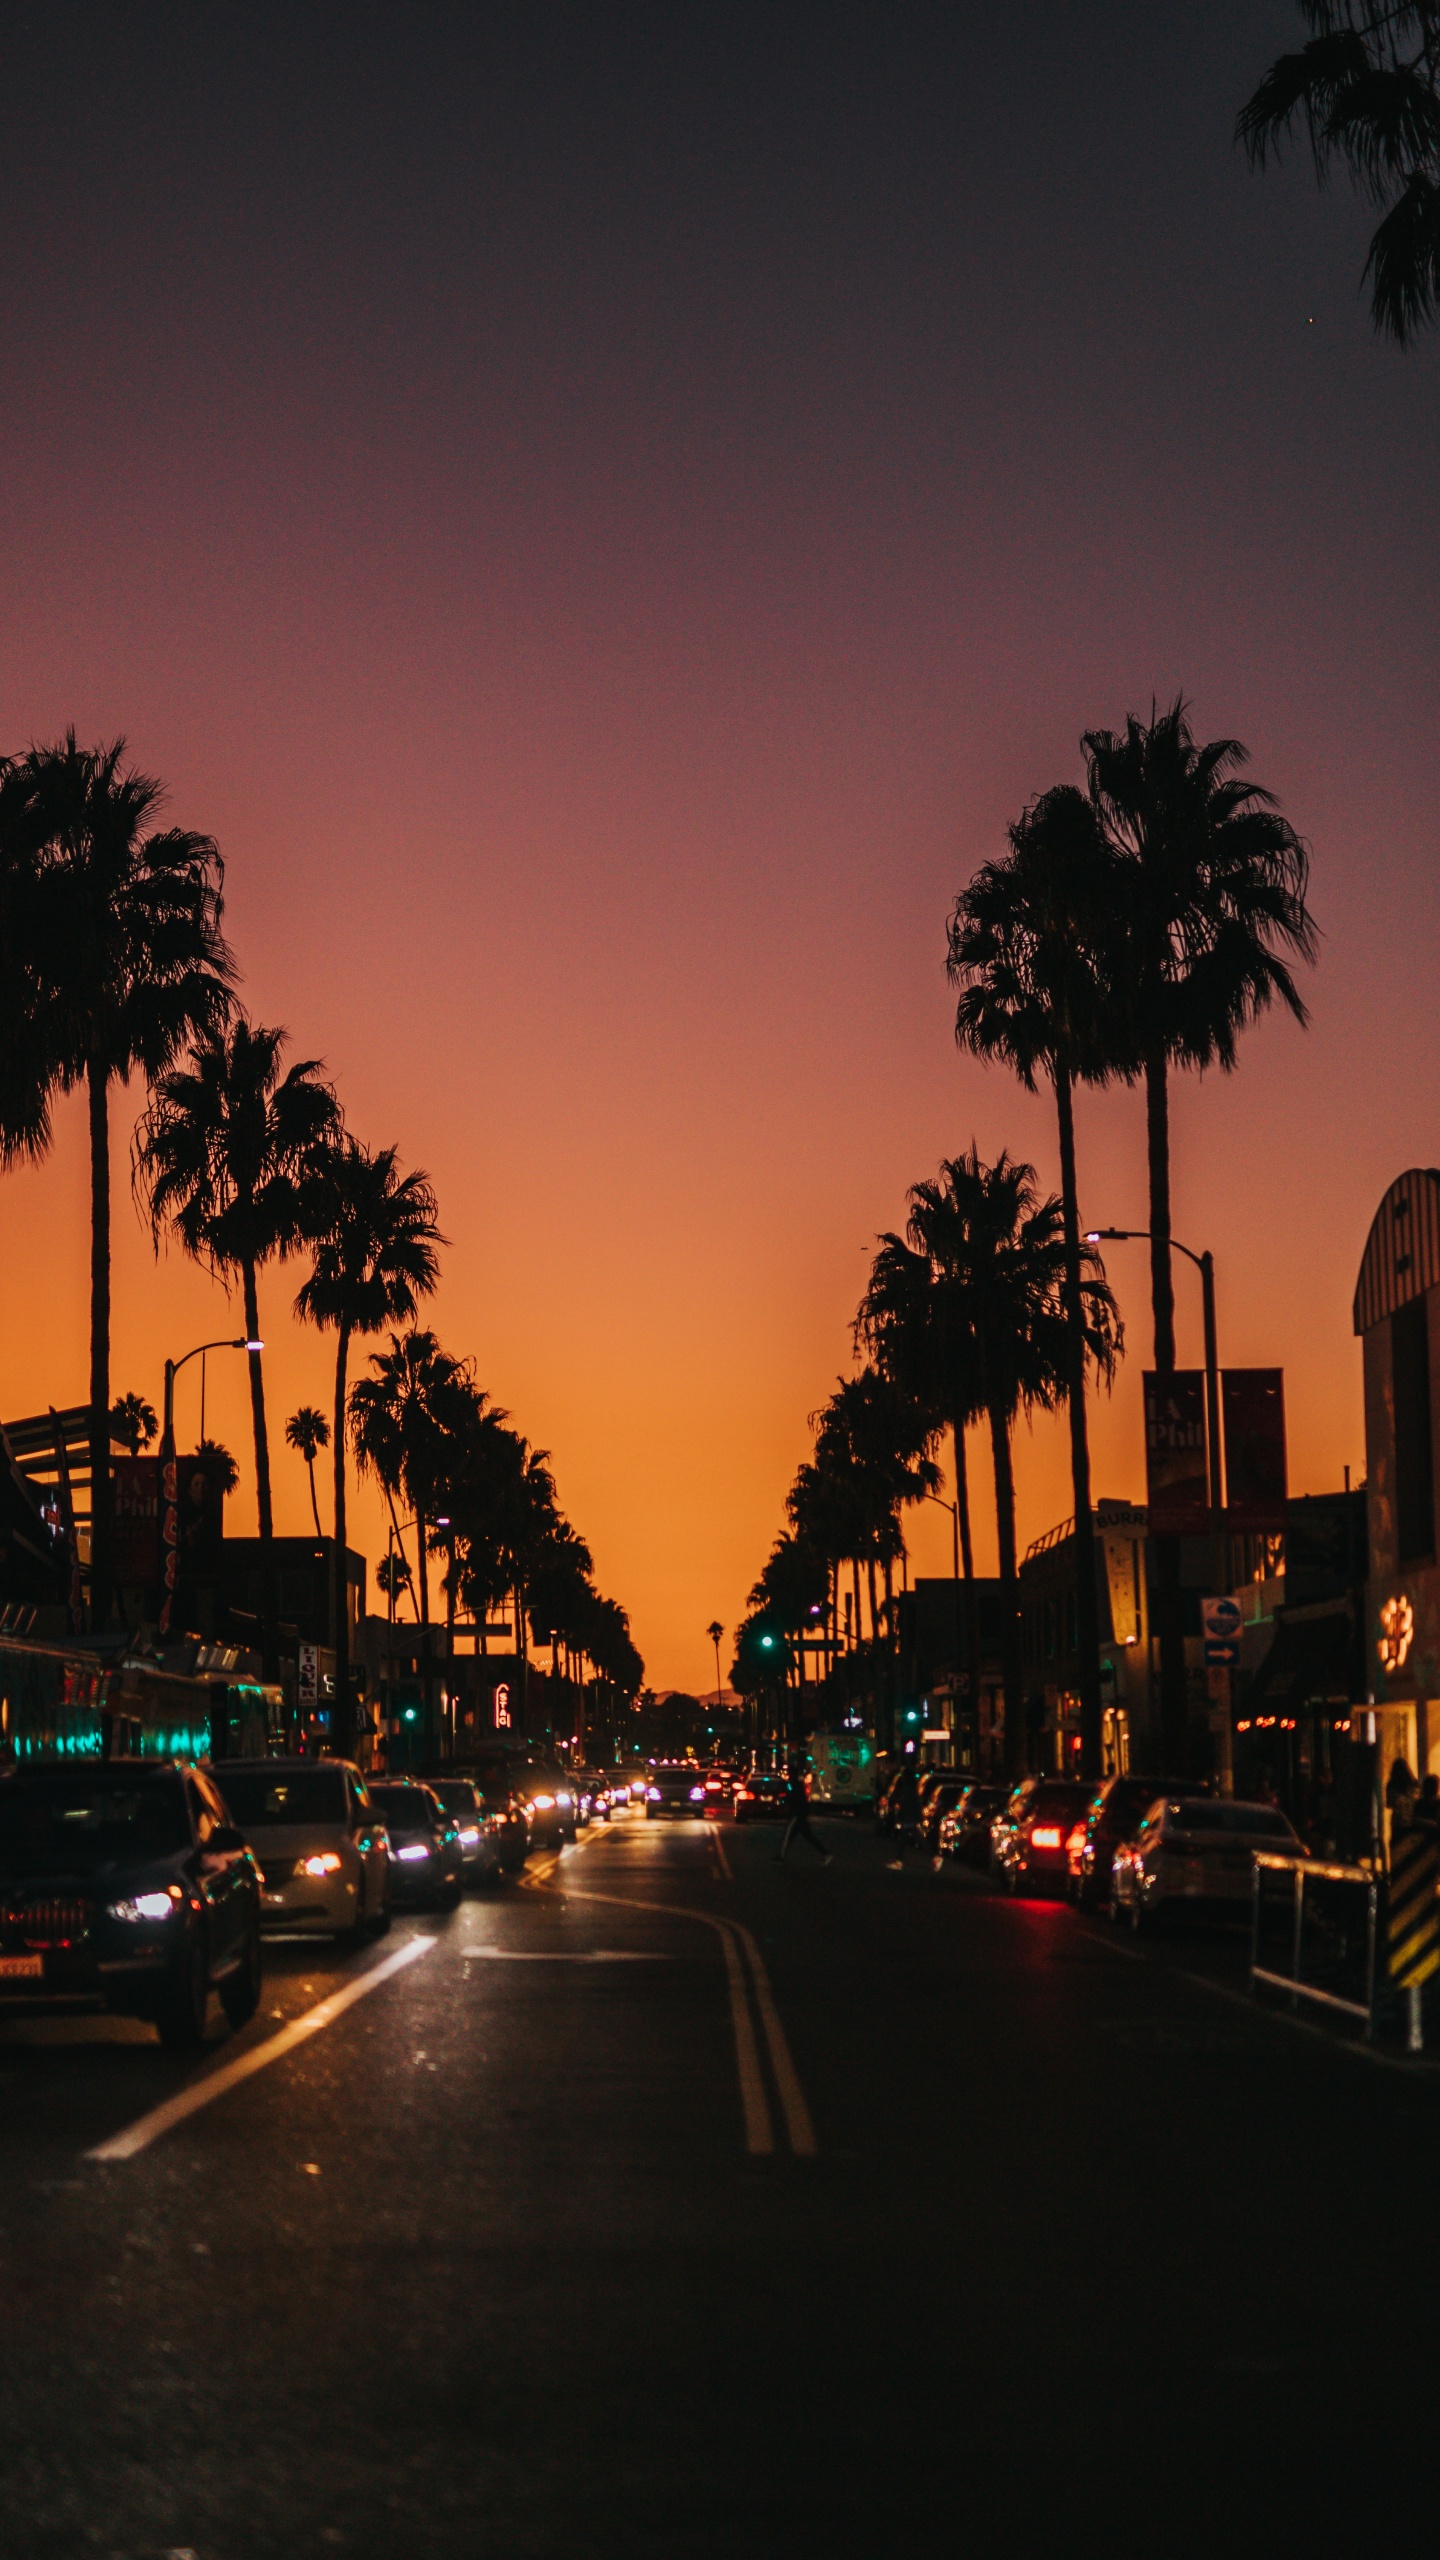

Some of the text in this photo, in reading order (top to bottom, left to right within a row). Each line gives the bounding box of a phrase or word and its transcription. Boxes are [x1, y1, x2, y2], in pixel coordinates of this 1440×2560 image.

[1148, 1397, 1182, 1421] LA
[1148, 1421, 1203, 1447] Phil
[115, 1497, 158, 1517] Phil
